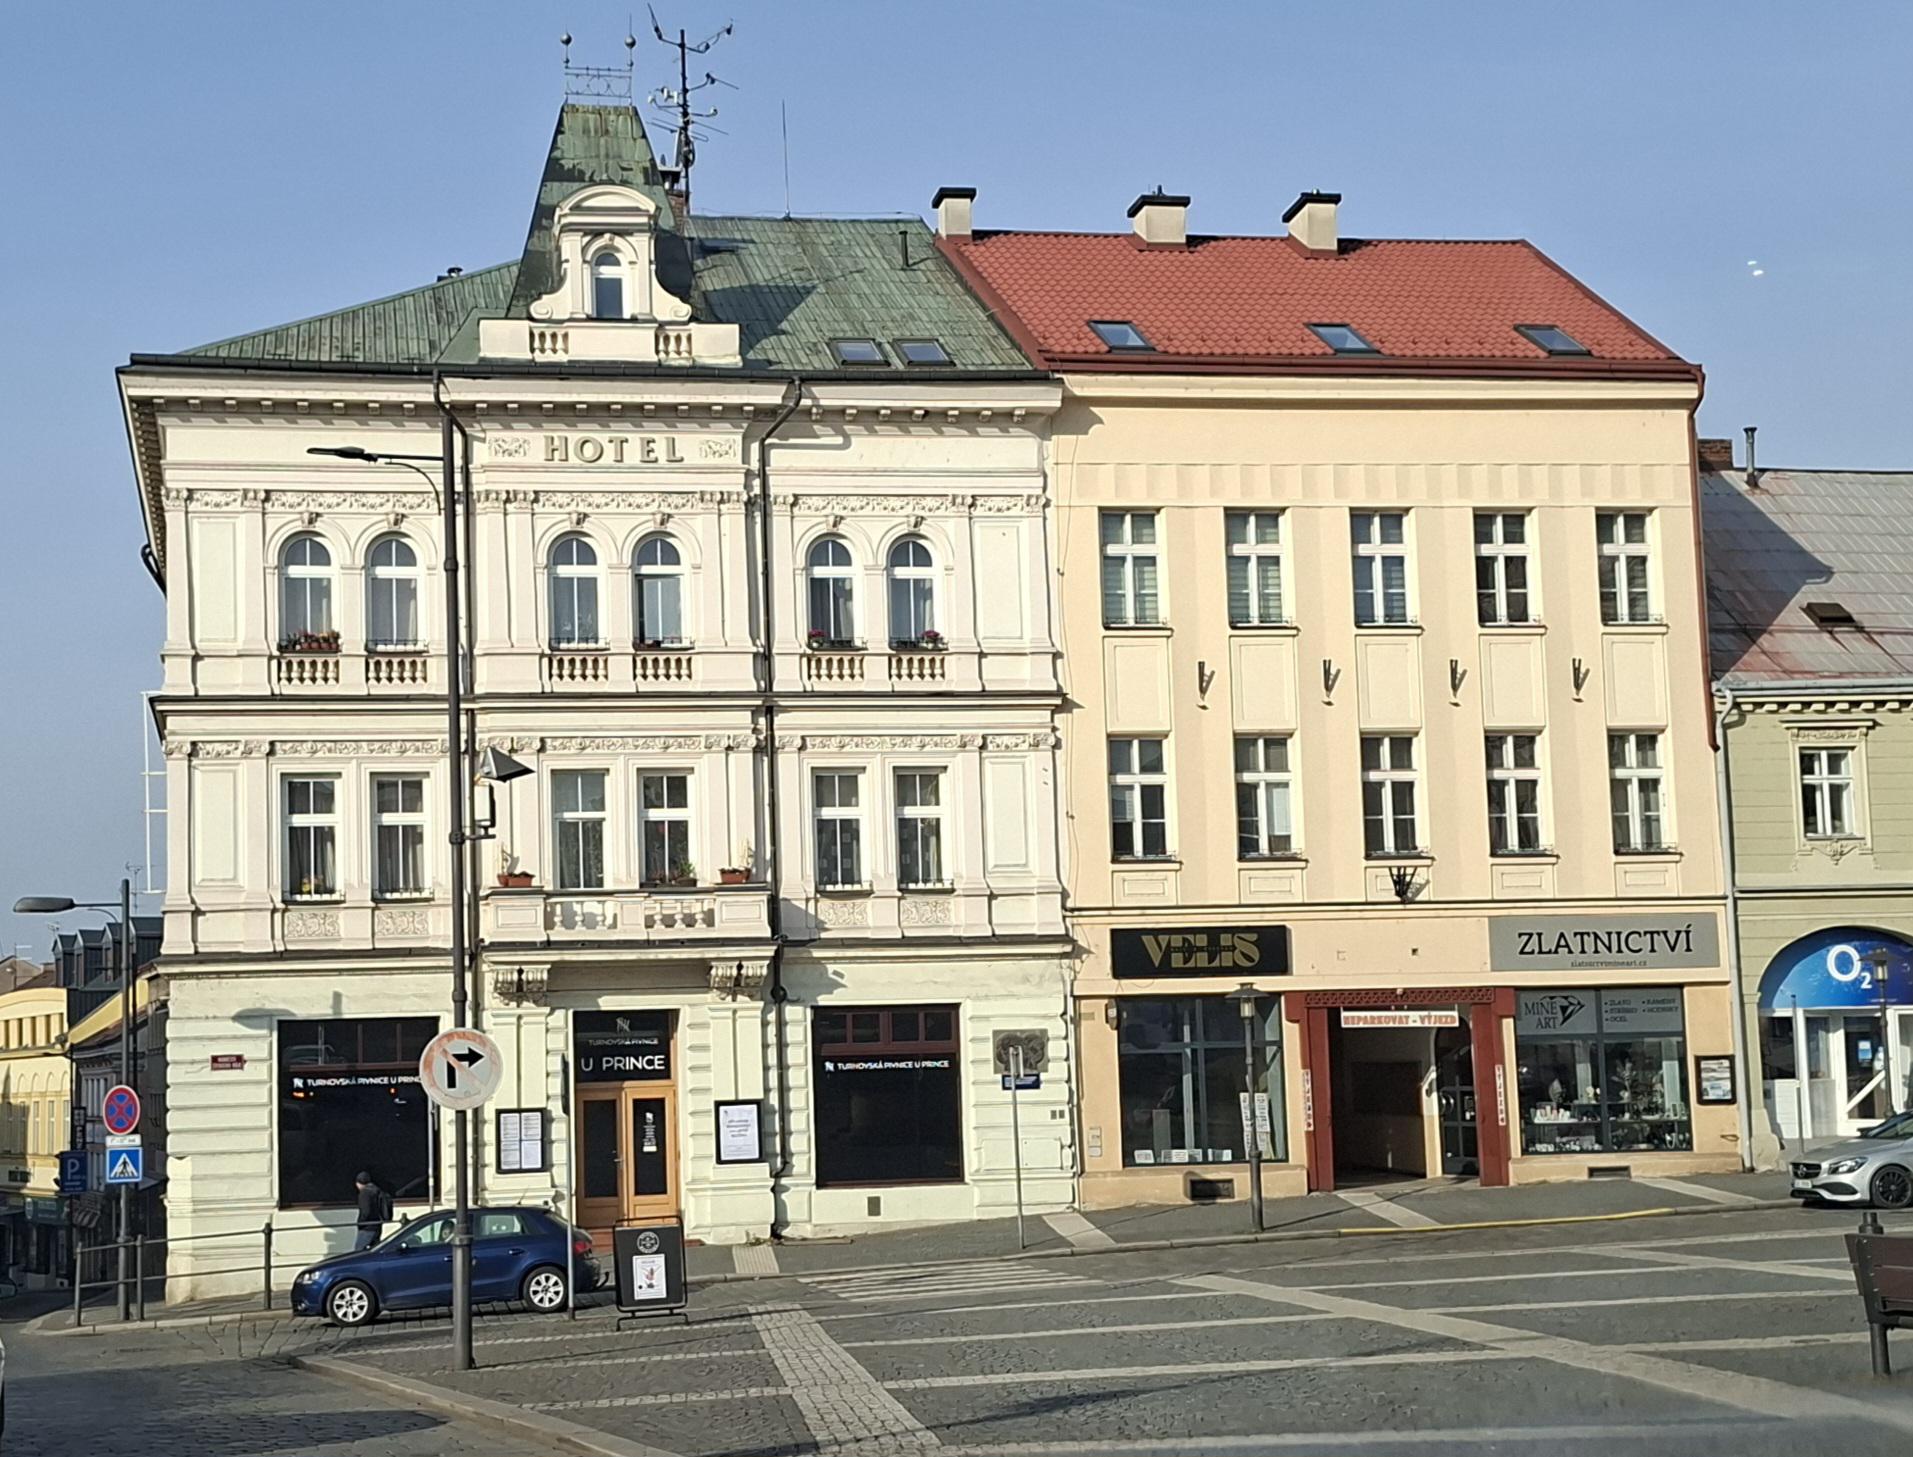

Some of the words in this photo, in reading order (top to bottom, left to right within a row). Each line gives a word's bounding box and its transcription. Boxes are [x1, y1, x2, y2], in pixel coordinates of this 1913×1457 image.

[543, 434, 685, 463] HOTEL
[1517, 923, 1693, 956] ZLATNICTVÍ
[1141, 933, 1260, 968] VELIS
[1524, 1001, 1558, 1017] MINE
[1343, 1015, 1410, 1026] NEPARKOVAT
[1535, 1016, 1559, 1029] ART
[581, 1057, 594, 1072] U
[602, 1055, 666, 1071] PRINCE
[837, 1060, 883, 1071] TURNOVSKÁ
[884, 1060, 914, 1070] PIVNICE
[914, 1060, 921, 1069] U
[921, 1060, 950, 1069] PRINCE
[307, 1076, 357, 1087] TURNOVSKÁ
[357, 1076, 389, 1085] PIVNICE
[390, 1076, 397, 1084] U
